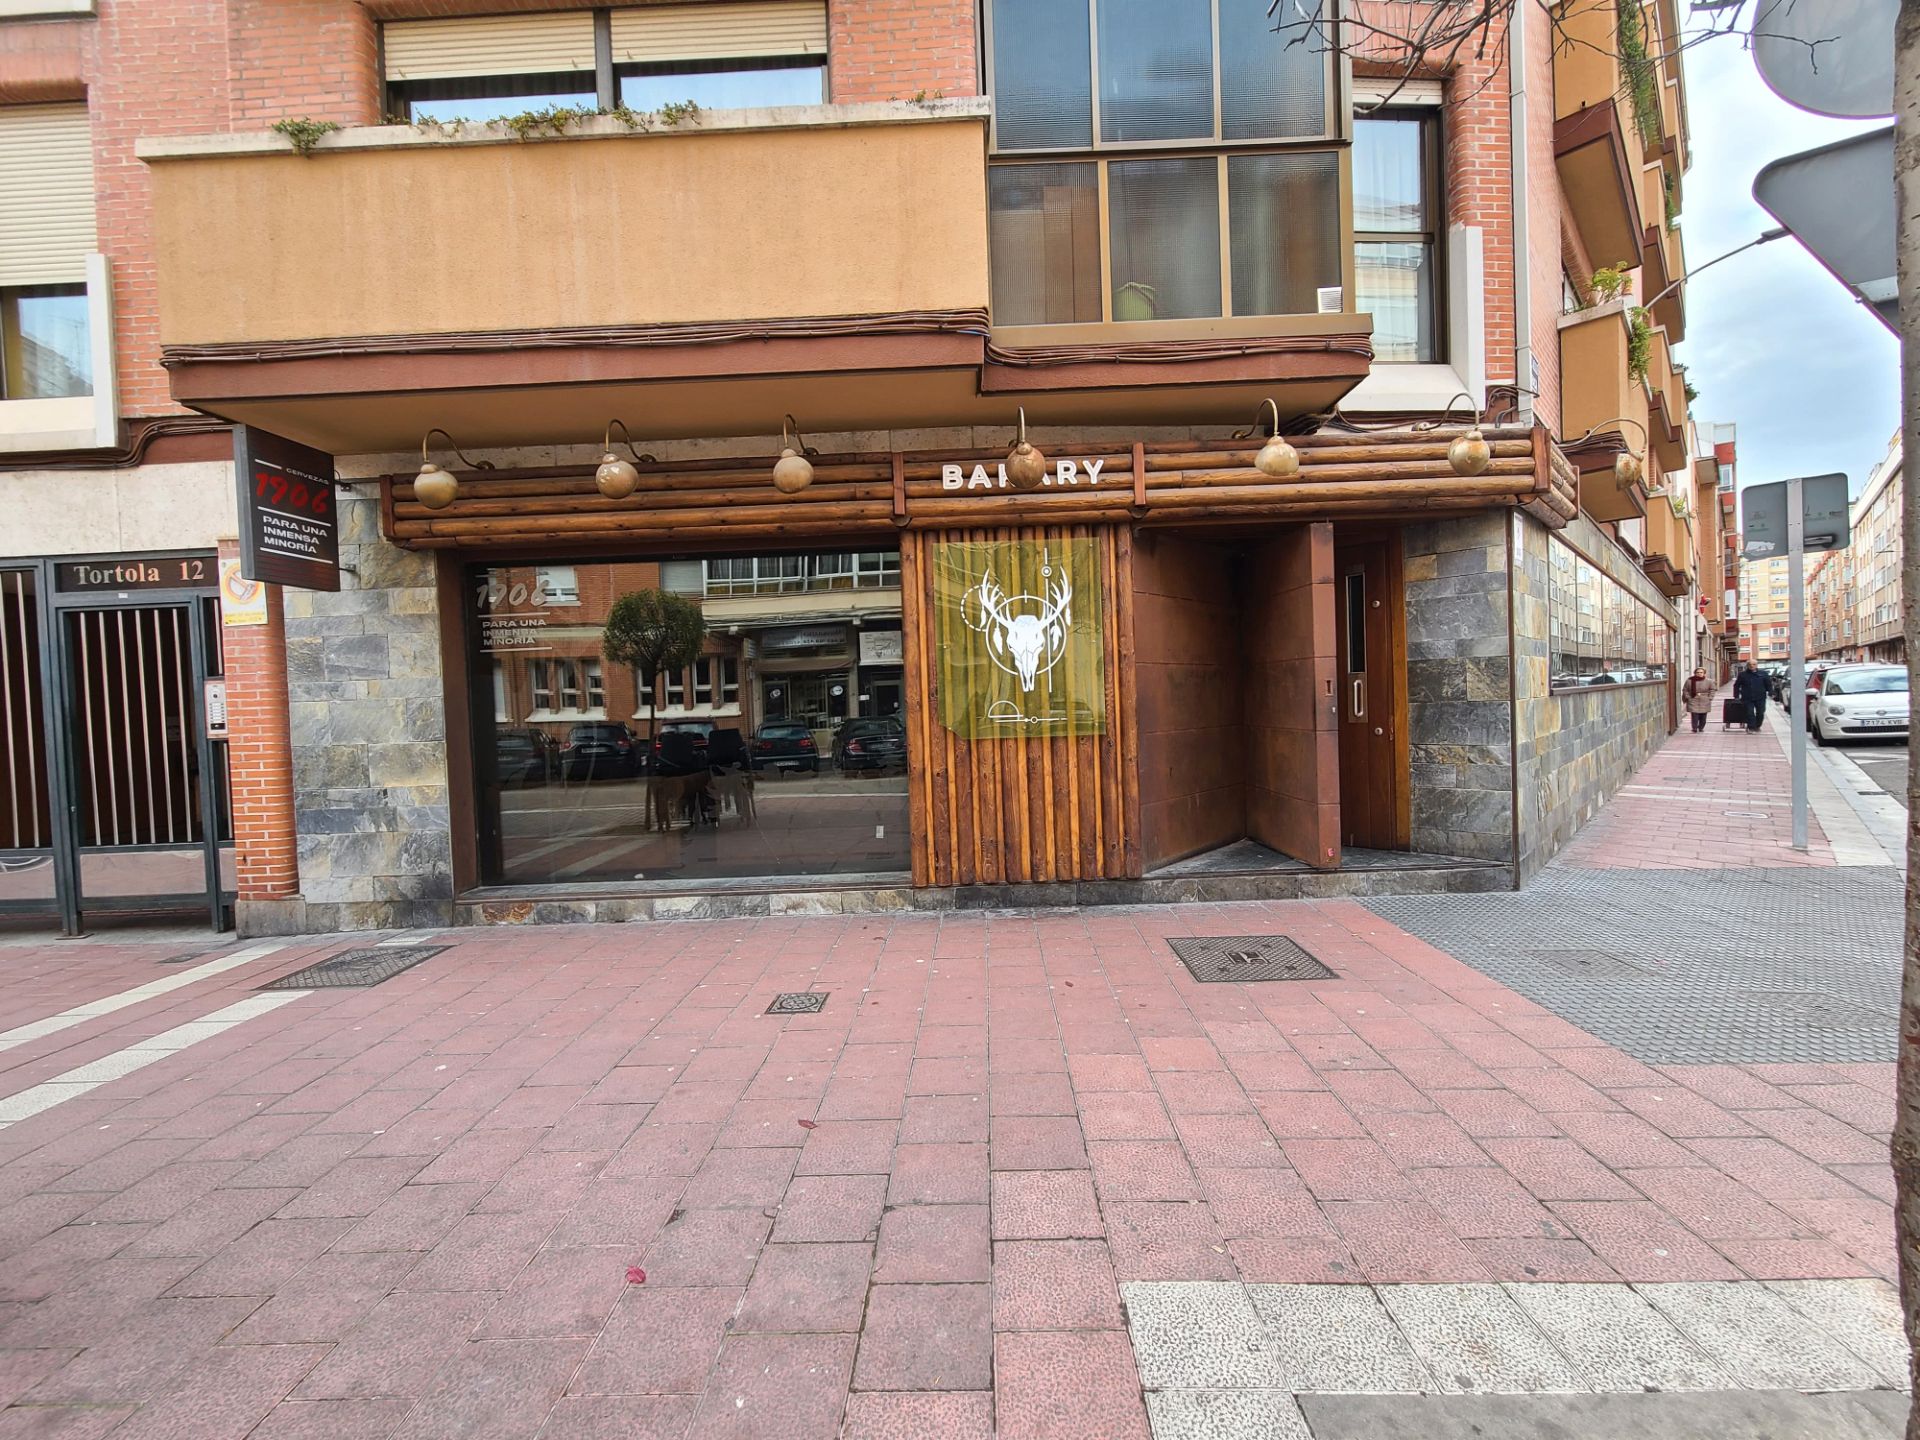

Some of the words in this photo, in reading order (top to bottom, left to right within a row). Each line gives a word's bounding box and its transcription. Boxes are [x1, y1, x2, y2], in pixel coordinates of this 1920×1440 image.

[286, 467, 329, 485] CERVEZAS
[255, 472, 329, 513] 1906
[262, 515, 299, 531] PARA
[302, 524, 328, 537] UNA
[263, 525, 320, 545] INMENSA
[264, 535, 317, 554] MINORÍA
[73, 563, 160, 585] Tortola
[179, 560, 204, 581] 12
[476, 579, 550, 610] 1906
[482, 620, 517, 628] PARA
[520, 619, 546, 627] UNA
[482, 628, 538, 637] INMENSA
